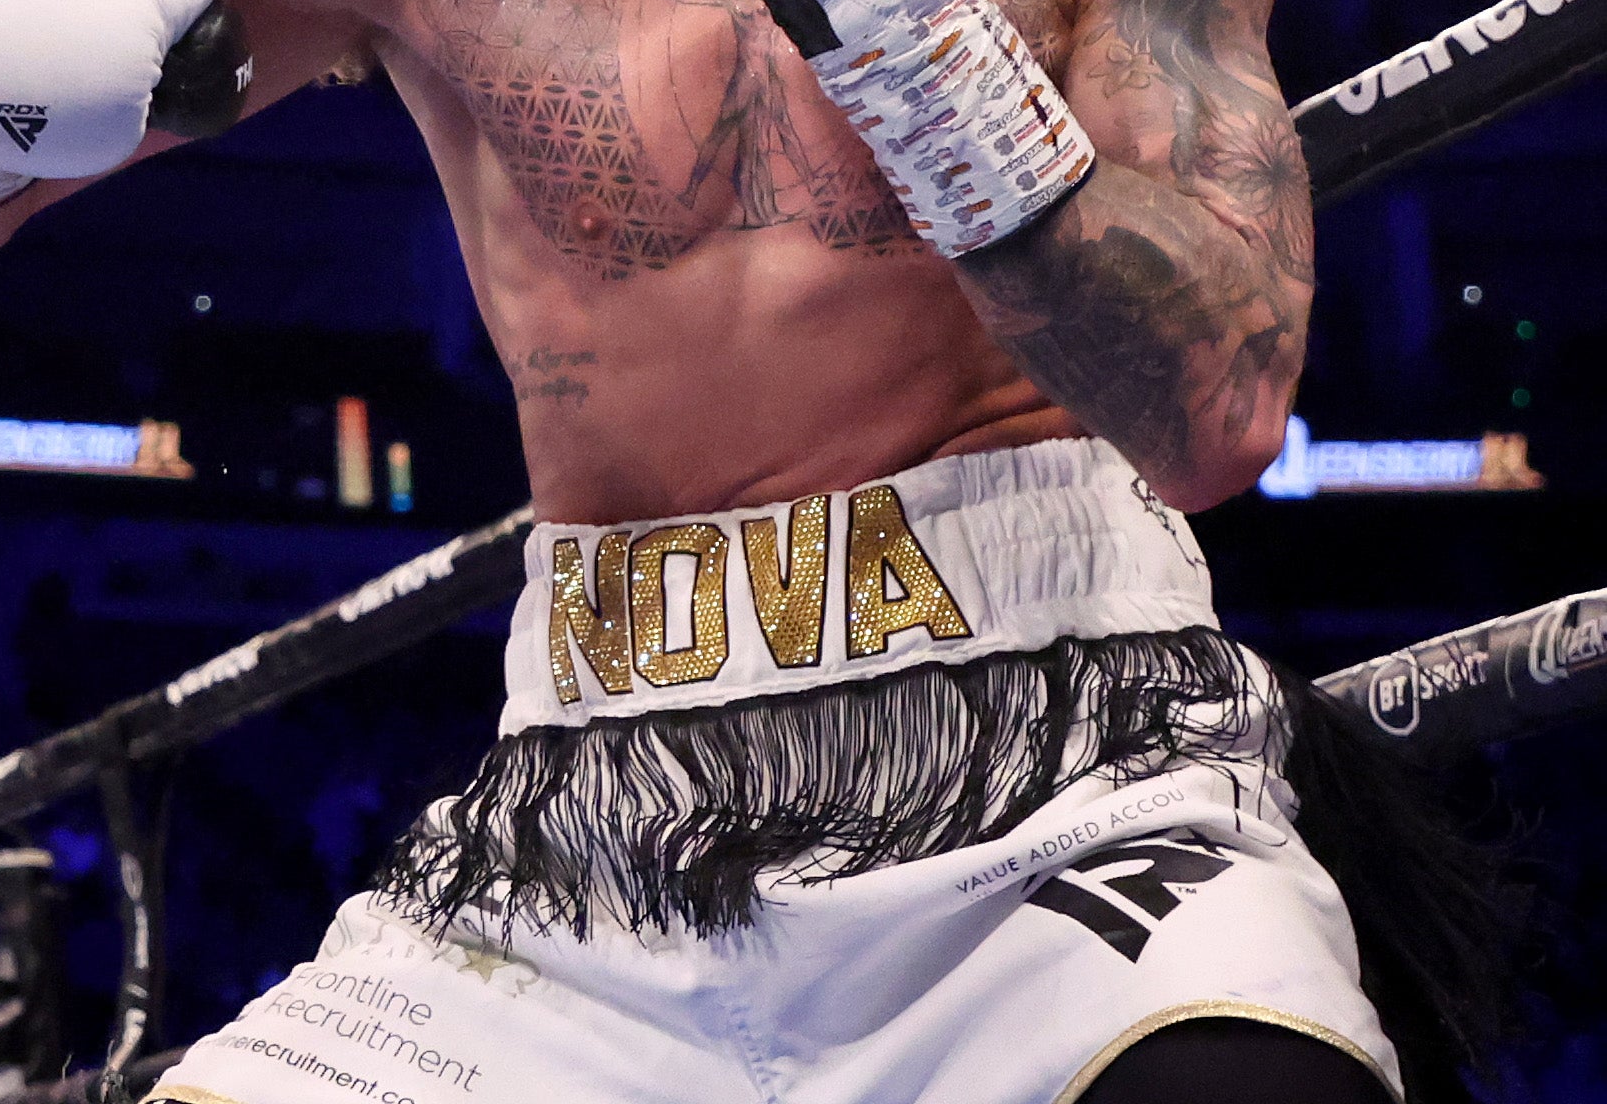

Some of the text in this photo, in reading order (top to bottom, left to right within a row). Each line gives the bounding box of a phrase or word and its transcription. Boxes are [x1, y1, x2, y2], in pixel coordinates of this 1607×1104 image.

[549, 485, 973, 705] NOVA
[955, 856, 1020, 894] VALUE
[1029, 822, 1101, 863] ADDED
[1109, 787, 1186, 829] ACCOU
[264, 992, 482, 1093] Recruitment
[296, 964, 432, 1026] Frontline
